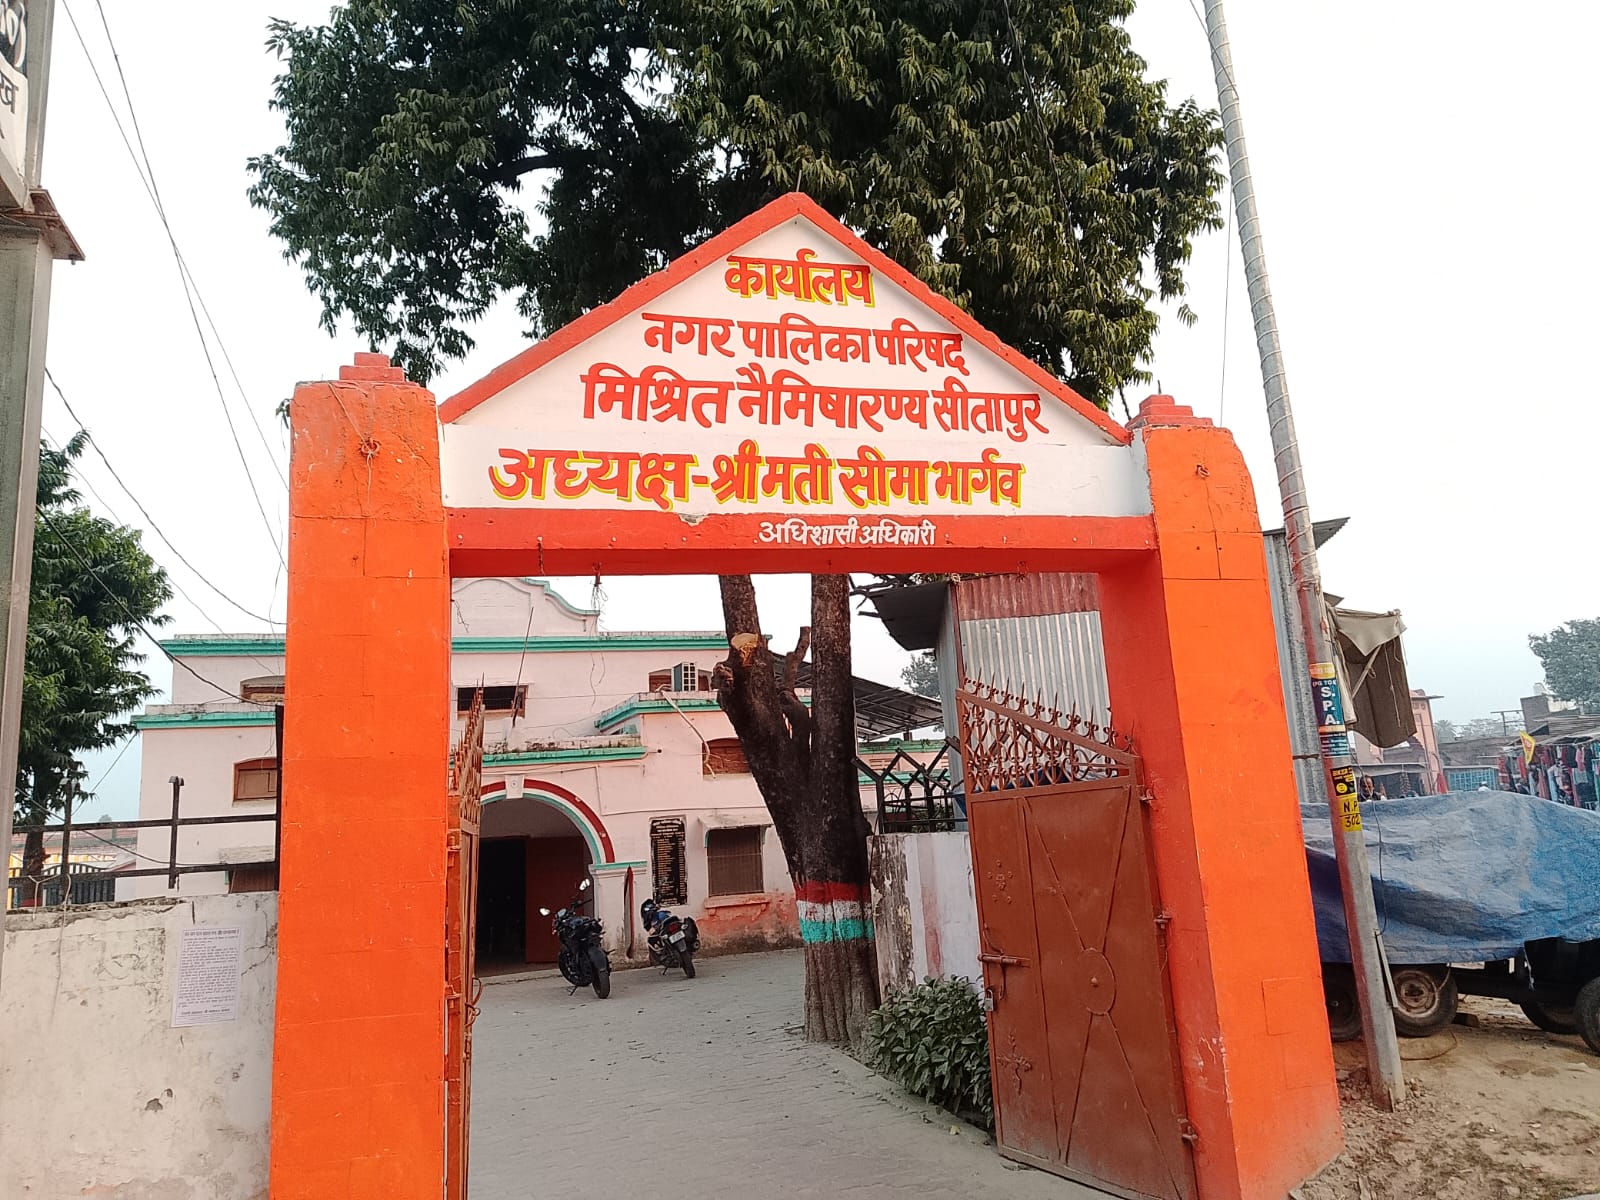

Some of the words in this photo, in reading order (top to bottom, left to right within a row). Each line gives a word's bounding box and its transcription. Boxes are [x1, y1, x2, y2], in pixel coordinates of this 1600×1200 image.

[724, 248, 875, 307] कार्यालय
[641, 312, 735, 357] नगर
[736, 312, 871, 365] पालिका
[873, 317, 970, 376] परिषद
[580, 362, 735, 428] मिश्रित
[736, 362, 929, 432] नैमिषारण्य
[931, 376, 1049, 442] सीतापुर
[836, 445, 930, 509] सीमा
[931, 447, 1026, 508] भार्गव
[758, 516, 859, 546] अधिशासी
[859, 518, 937, 546] अधिकारी
